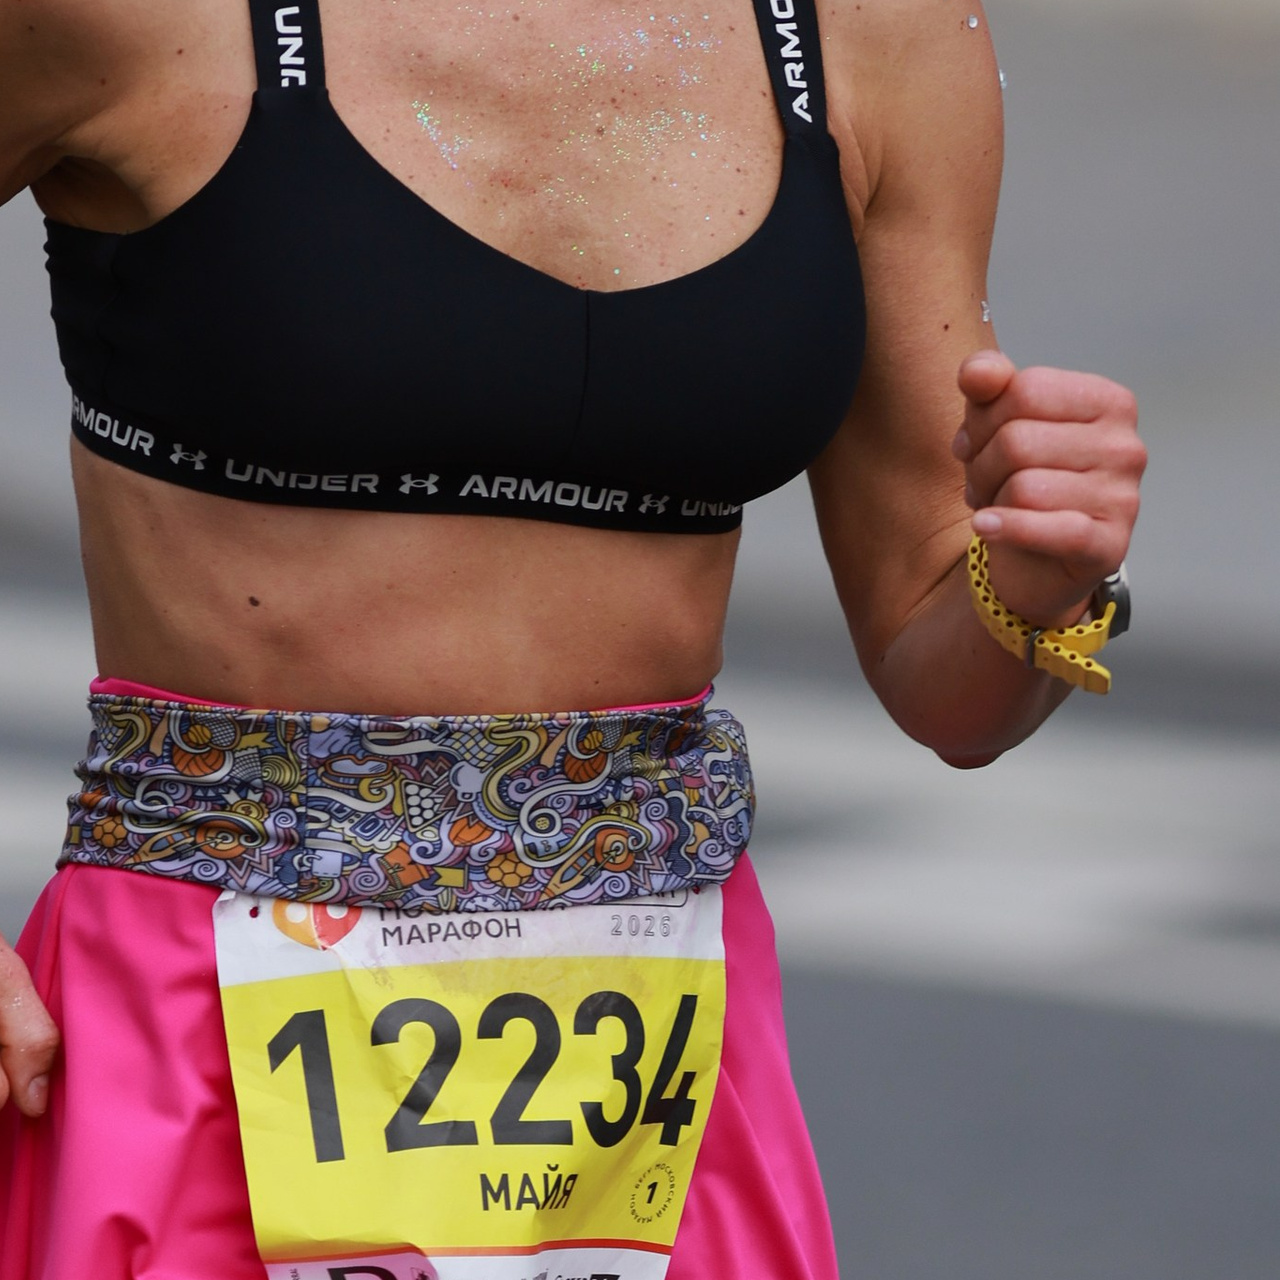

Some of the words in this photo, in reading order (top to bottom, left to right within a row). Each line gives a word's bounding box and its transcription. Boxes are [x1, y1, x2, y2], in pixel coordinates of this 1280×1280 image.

[225, 458, 379, 494] UNDER
[459, 474, 629, 513] ARMOUR
[382, 917, 522, 947] МАРАФОН
[266, 990, 699, 1164] 12234
[480, 1163, 578, 1212] МАЙЯ
[646, 1181, 658, 1205] 1
